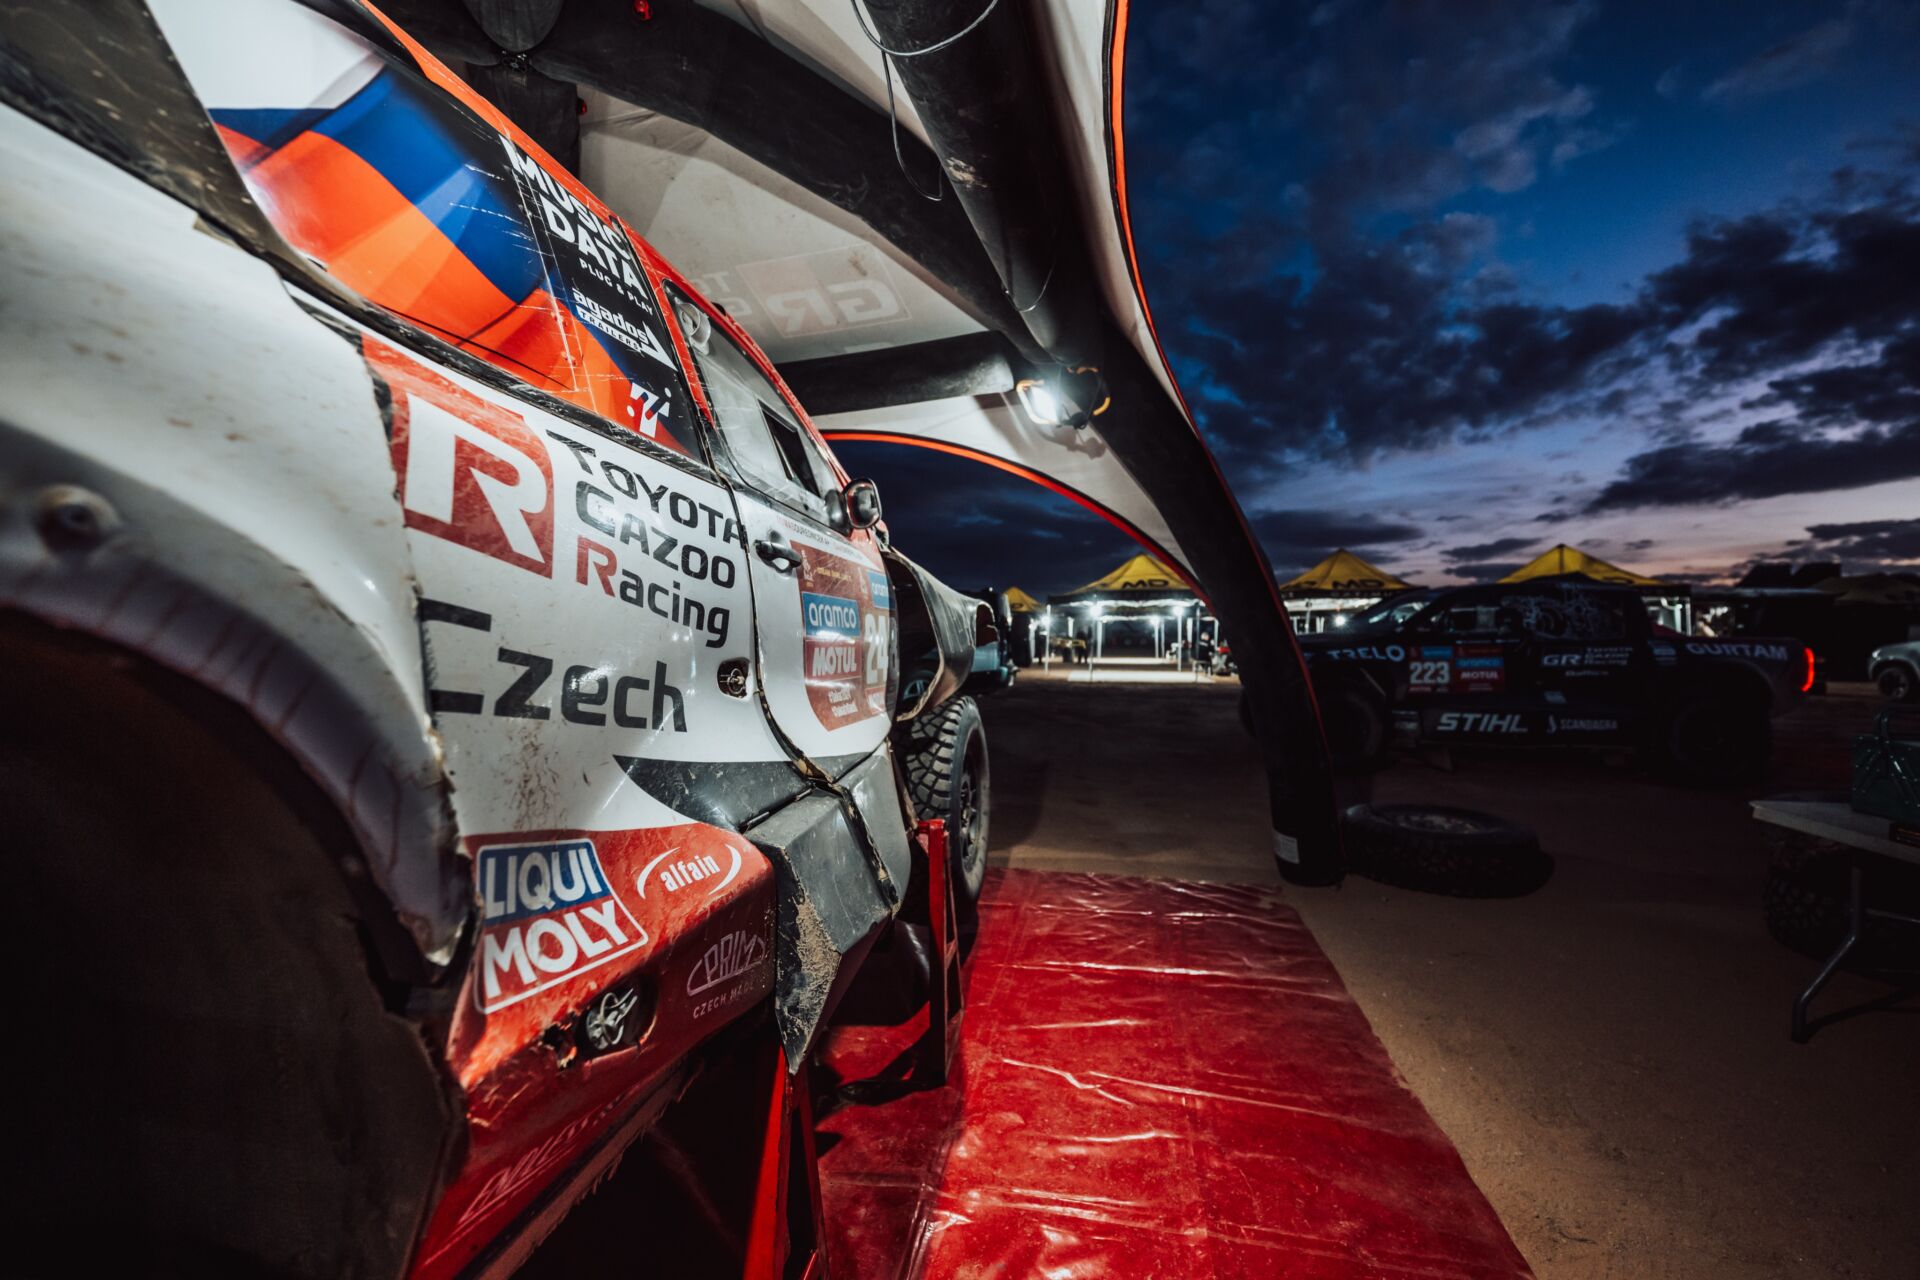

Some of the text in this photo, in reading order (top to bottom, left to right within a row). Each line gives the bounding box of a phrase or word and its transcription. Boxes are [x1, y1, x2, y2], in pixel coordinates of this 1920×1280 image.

[498, 133, 631, 261] MUSIC
[539, 194, 648, 300] DATA
[579, 257, 654, 317] PLUG & PLAY
[571, 287, 650, 345] agados
[577, 309, 642, 352] TRAILERS
[545, 428, 749, 554] TOYOTA
[575, 480, 736, 590] GAZOO
[575, 534, 730, 650] Racing
[808, 602, 857, 630] aramco
[812, 646, 857, 678] MOTUL
[1409, 661, 1451, 685] 223
[1460, 671, 1499, 680] MOTUL
[1542, 653, 1582, 666] GR
[1436, 712, 1528, 732] STIHL
[485, 848, 603, 918] LIQUI
[659, 852, 722, 894] alfain
[484, 899, 629, 999] MOLY
[703, 930, 758, 984] PRIM
[692, 996, 726, 1020] CZECH
